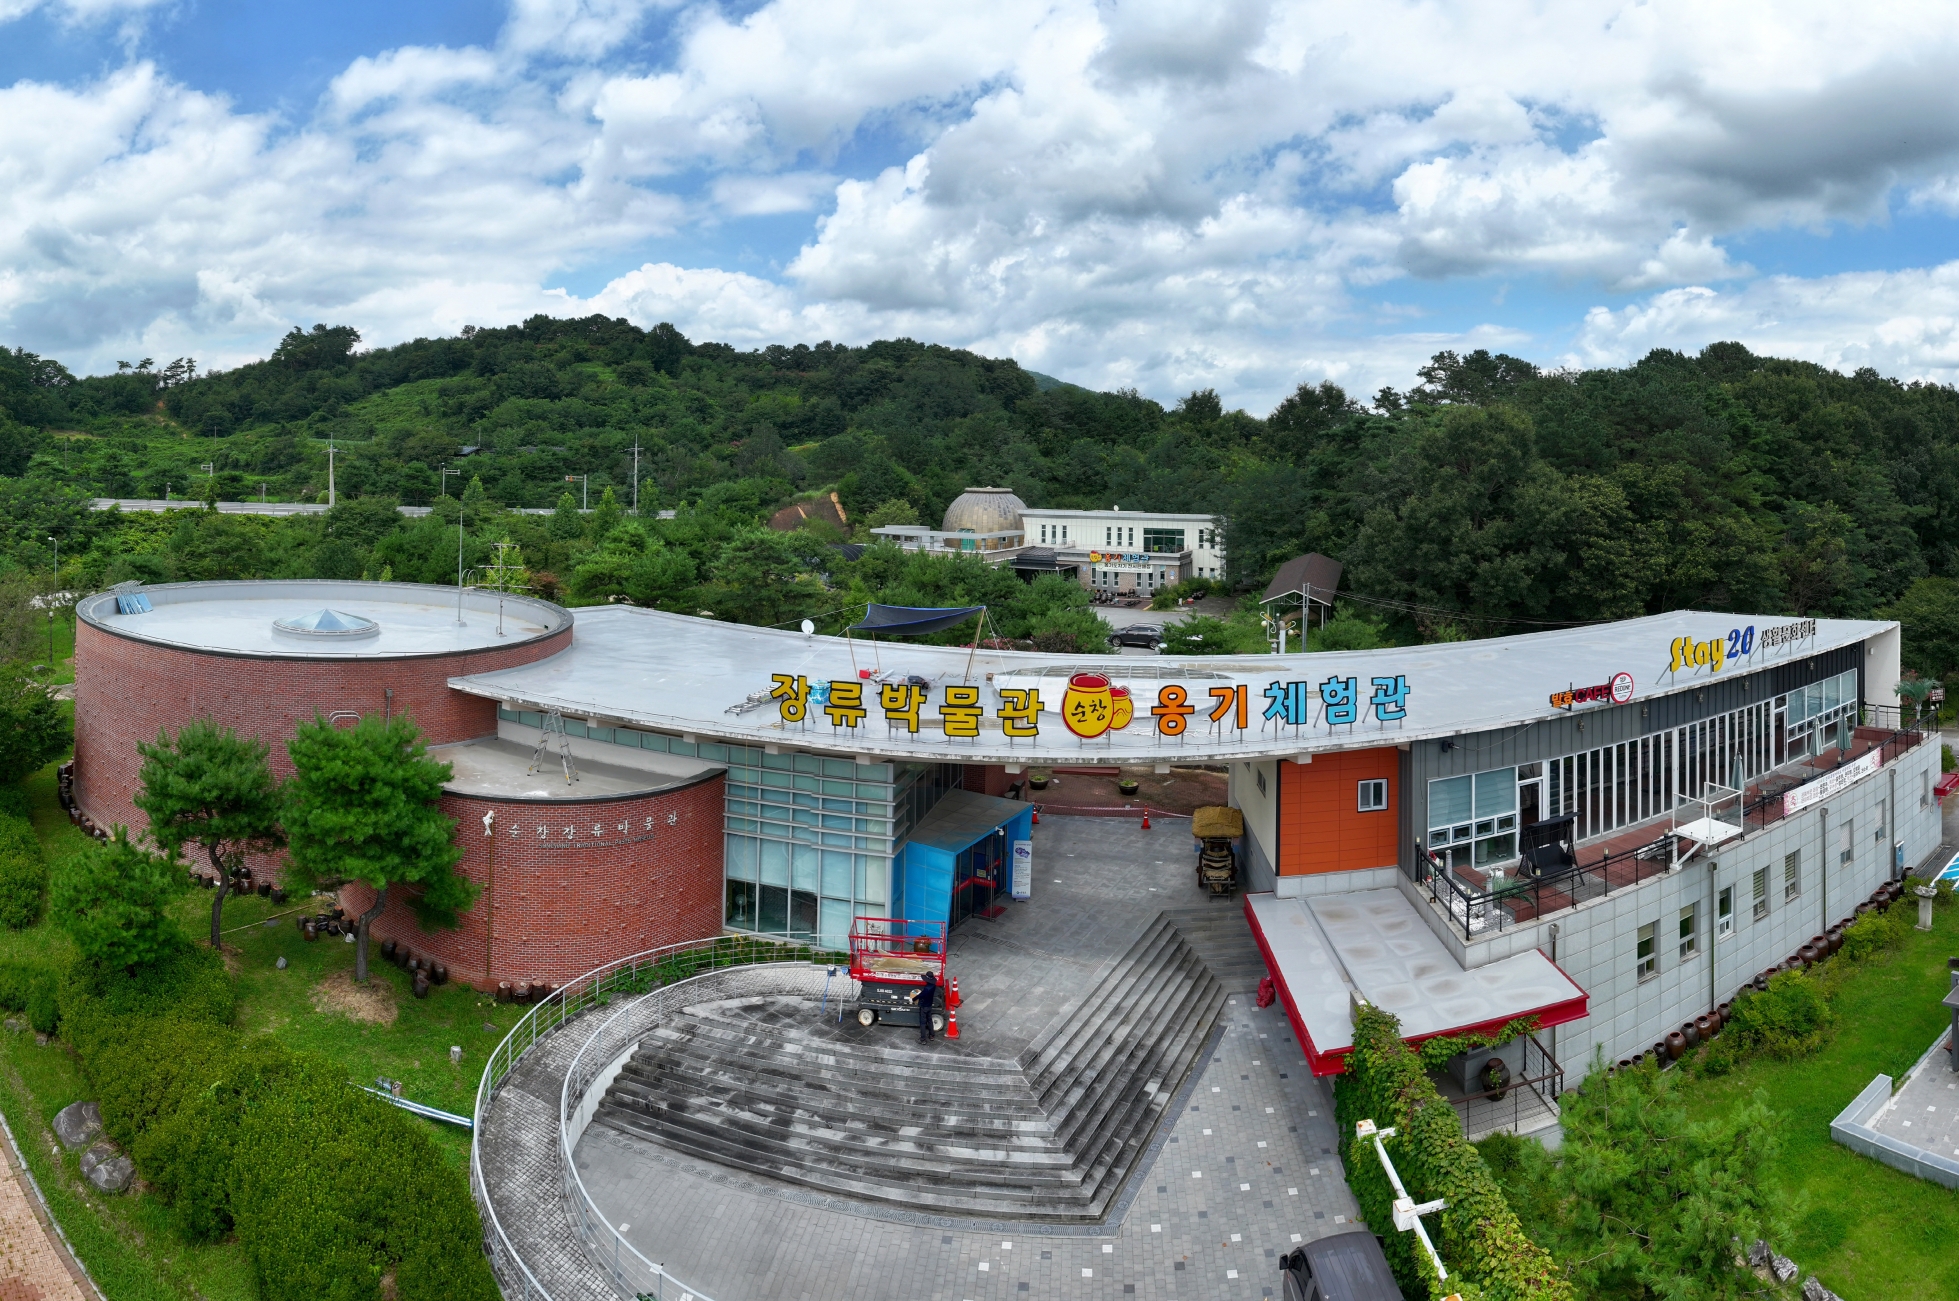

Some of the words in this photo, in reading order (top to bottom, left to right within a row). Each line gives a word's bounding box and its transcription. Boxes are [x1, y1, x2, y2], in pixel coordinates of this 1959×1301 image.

[1670, 636, 1724, 672] Stay
[1727, 625, 1755, 659] 20
[1761, 619, 1817, 648] 생활문화센터
[770, 673, 1045, 737] 장류박물관
[1071, 698, 1107, 723] 순창
[1151, 675, 1411, 736] 옹기체험관
[1549, 690, 1573, 708] 발효
[1575, 684, 1611, 703] CAFE
